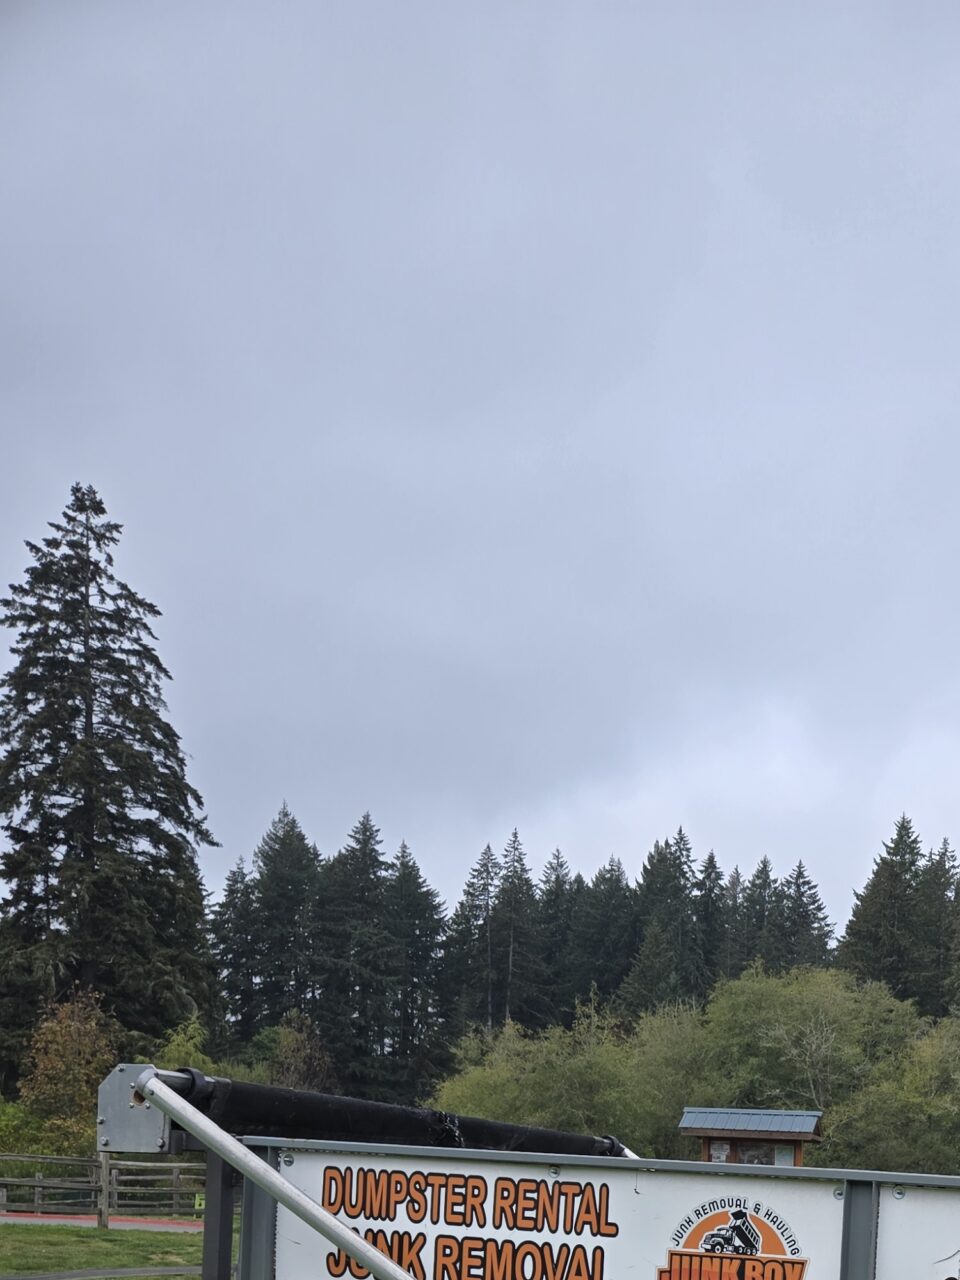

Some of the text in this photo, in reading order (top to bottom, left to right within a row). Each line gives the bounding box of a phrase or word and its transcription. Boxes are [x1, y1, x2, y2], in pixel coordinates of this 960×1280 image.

[322, 1166, 619, 1238] DUMPSTER RENTAL
[671, 1197, 800, 1256] JUNK REMOVAL & HAULING
